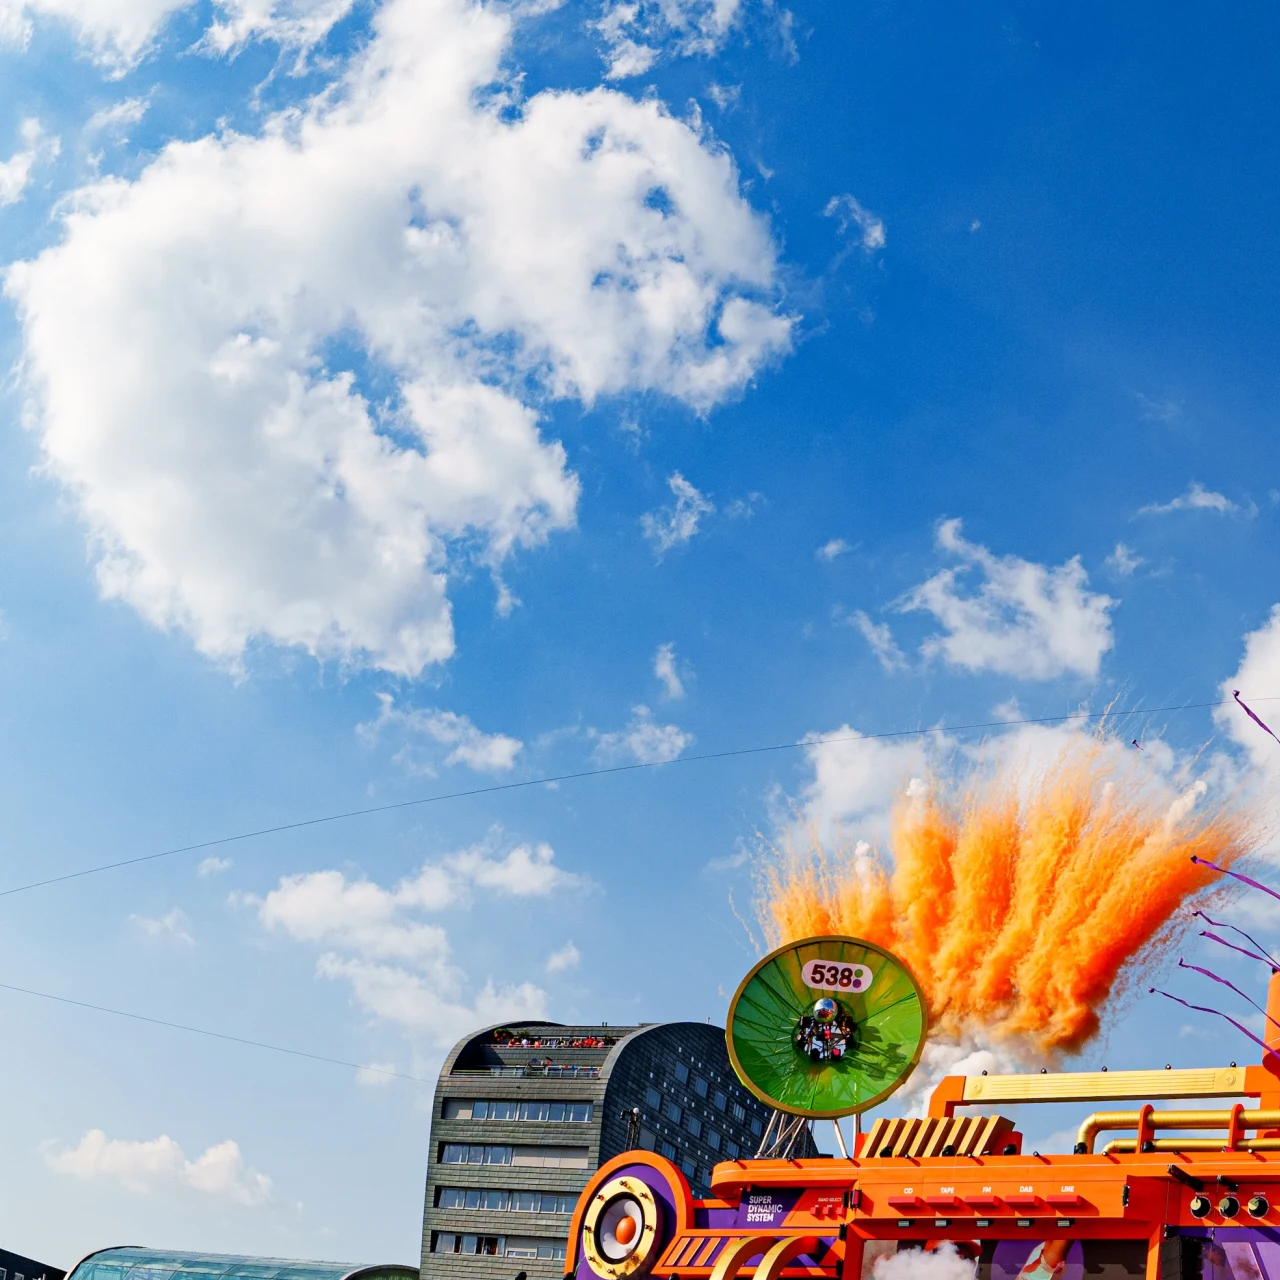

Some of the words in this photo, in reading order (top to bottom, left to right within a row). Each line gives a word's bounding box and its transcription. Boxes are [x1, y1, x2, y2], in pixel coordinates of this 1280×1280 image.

[811, 963, 853, 988] 538
[903, 1187, 914, 1195] CD
[940, 1186, 955, 1194] TAPE
[1019, 1185, 1034, 1193] DAB
[1061, 1185, 1075, 1193] LINE
[748, 1195, 773, 1205] SUPER
[747, 1204, 783, 1214] DYNAMIC
[746, 1213, 775, 1222] SYSTEM
